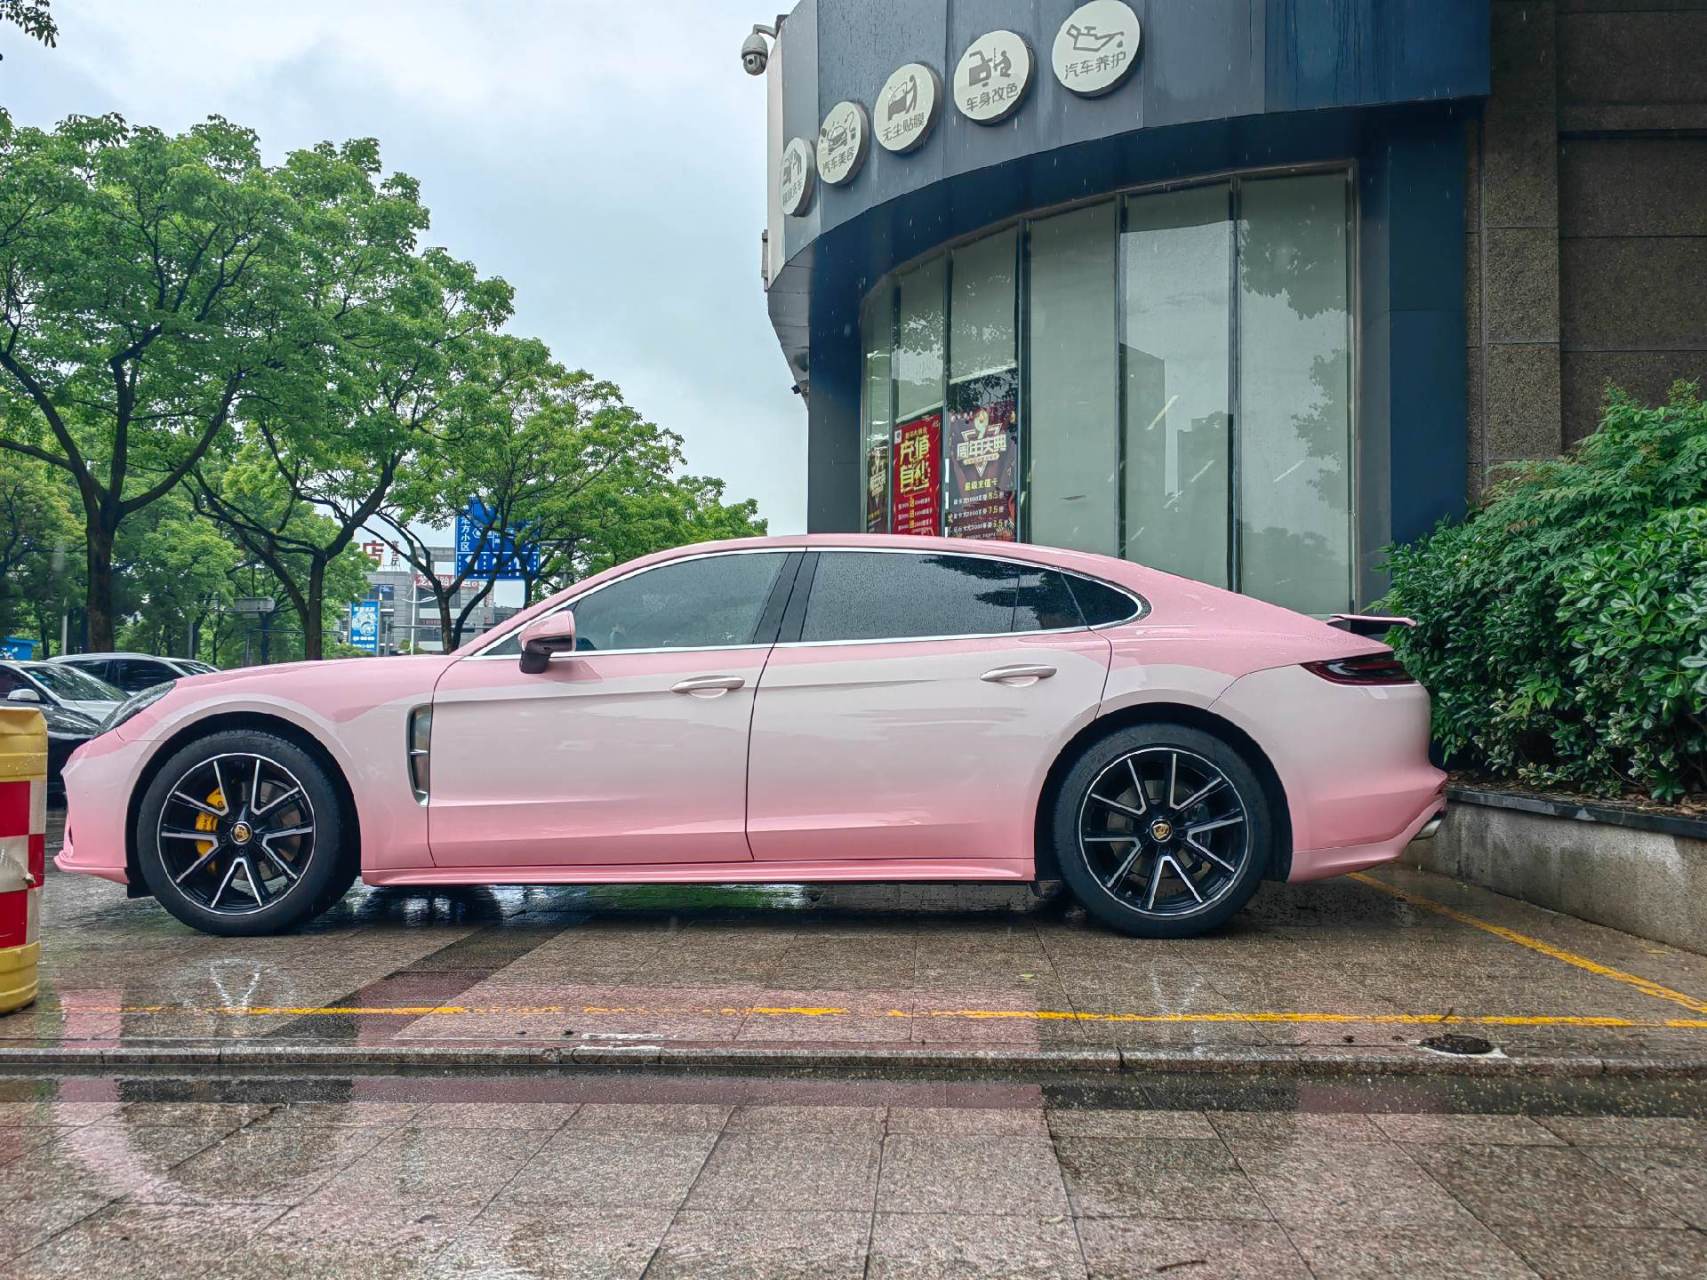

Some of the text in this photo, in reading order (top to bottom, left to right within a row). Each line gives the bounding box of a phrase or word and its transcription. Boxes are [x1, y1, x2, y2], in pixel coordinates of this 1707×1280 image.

[1064, 51, 1127, 80] 汽车养护
[965, 82, 1019, 111] 车身改色
[882, 112, 925, 143] 无尘贴膜
[822, 146, 855, 176] 汽车美容
[957, 434, 1007, 461] 周年庆典
